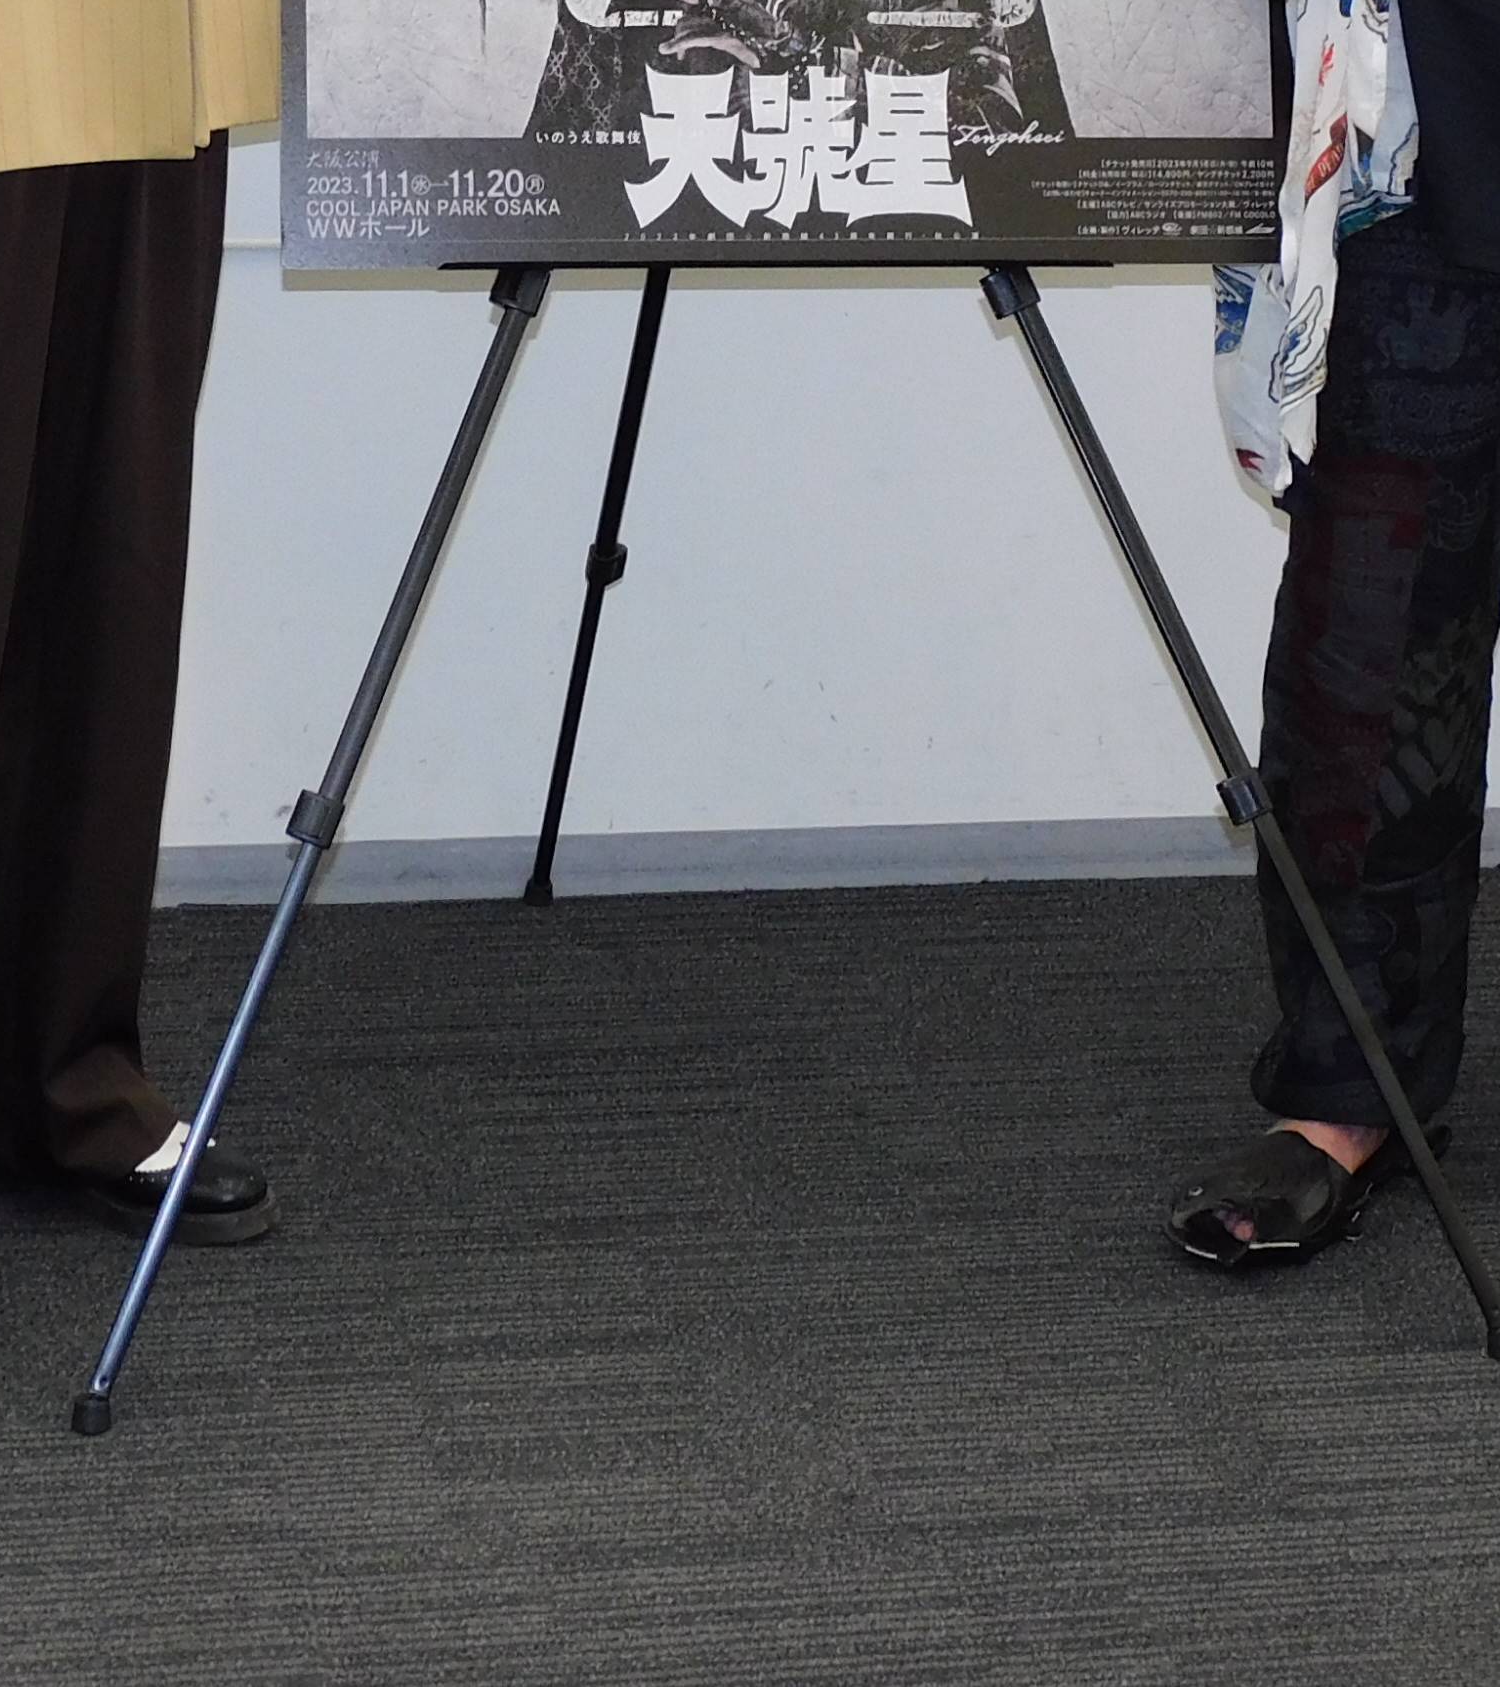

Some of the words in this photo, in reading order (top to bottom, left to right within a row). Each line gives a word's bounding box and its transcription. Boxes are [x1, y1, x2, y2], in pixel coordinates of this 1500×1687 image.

[535, 130, 641, 144] いのうえ歌舞伎
[624, 65, 973, 228] 天號星
[306, 200, 361, 216] COOL
[368, 199, 429, 216] JAPAN
[437, 199, 488, 216] PARK
[494, 199, 561, 216] OSAKA
